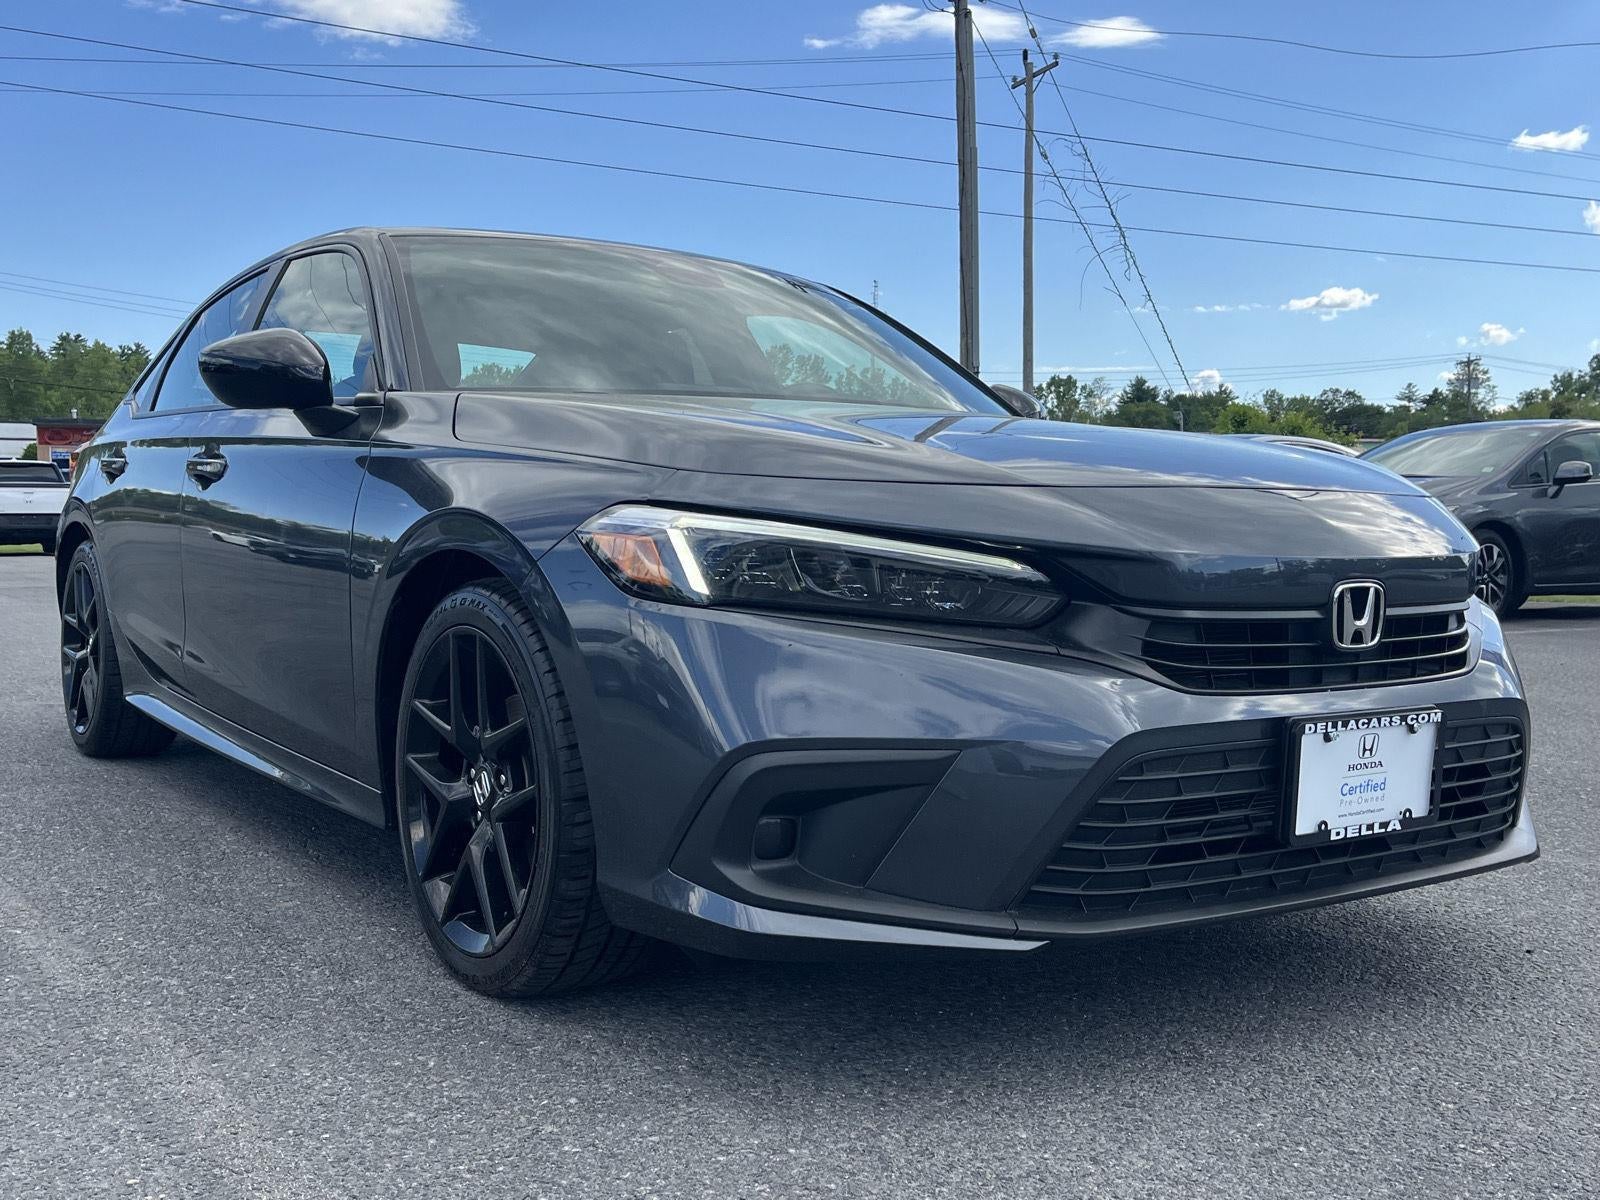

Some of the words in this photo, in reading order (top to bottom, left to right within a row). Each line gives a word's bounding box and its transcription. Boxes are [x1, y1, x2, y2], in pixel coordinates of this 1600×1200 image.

[1304, 712, 1443, 735] DELLACARS.COM
[1347, 760, 1384, 772] HONDA
[1340, 777, 1387, 797] Certified
[1339, 794, 1385, 807] Pre-Owned
[1330, 819, 1401, 841] DELLA
